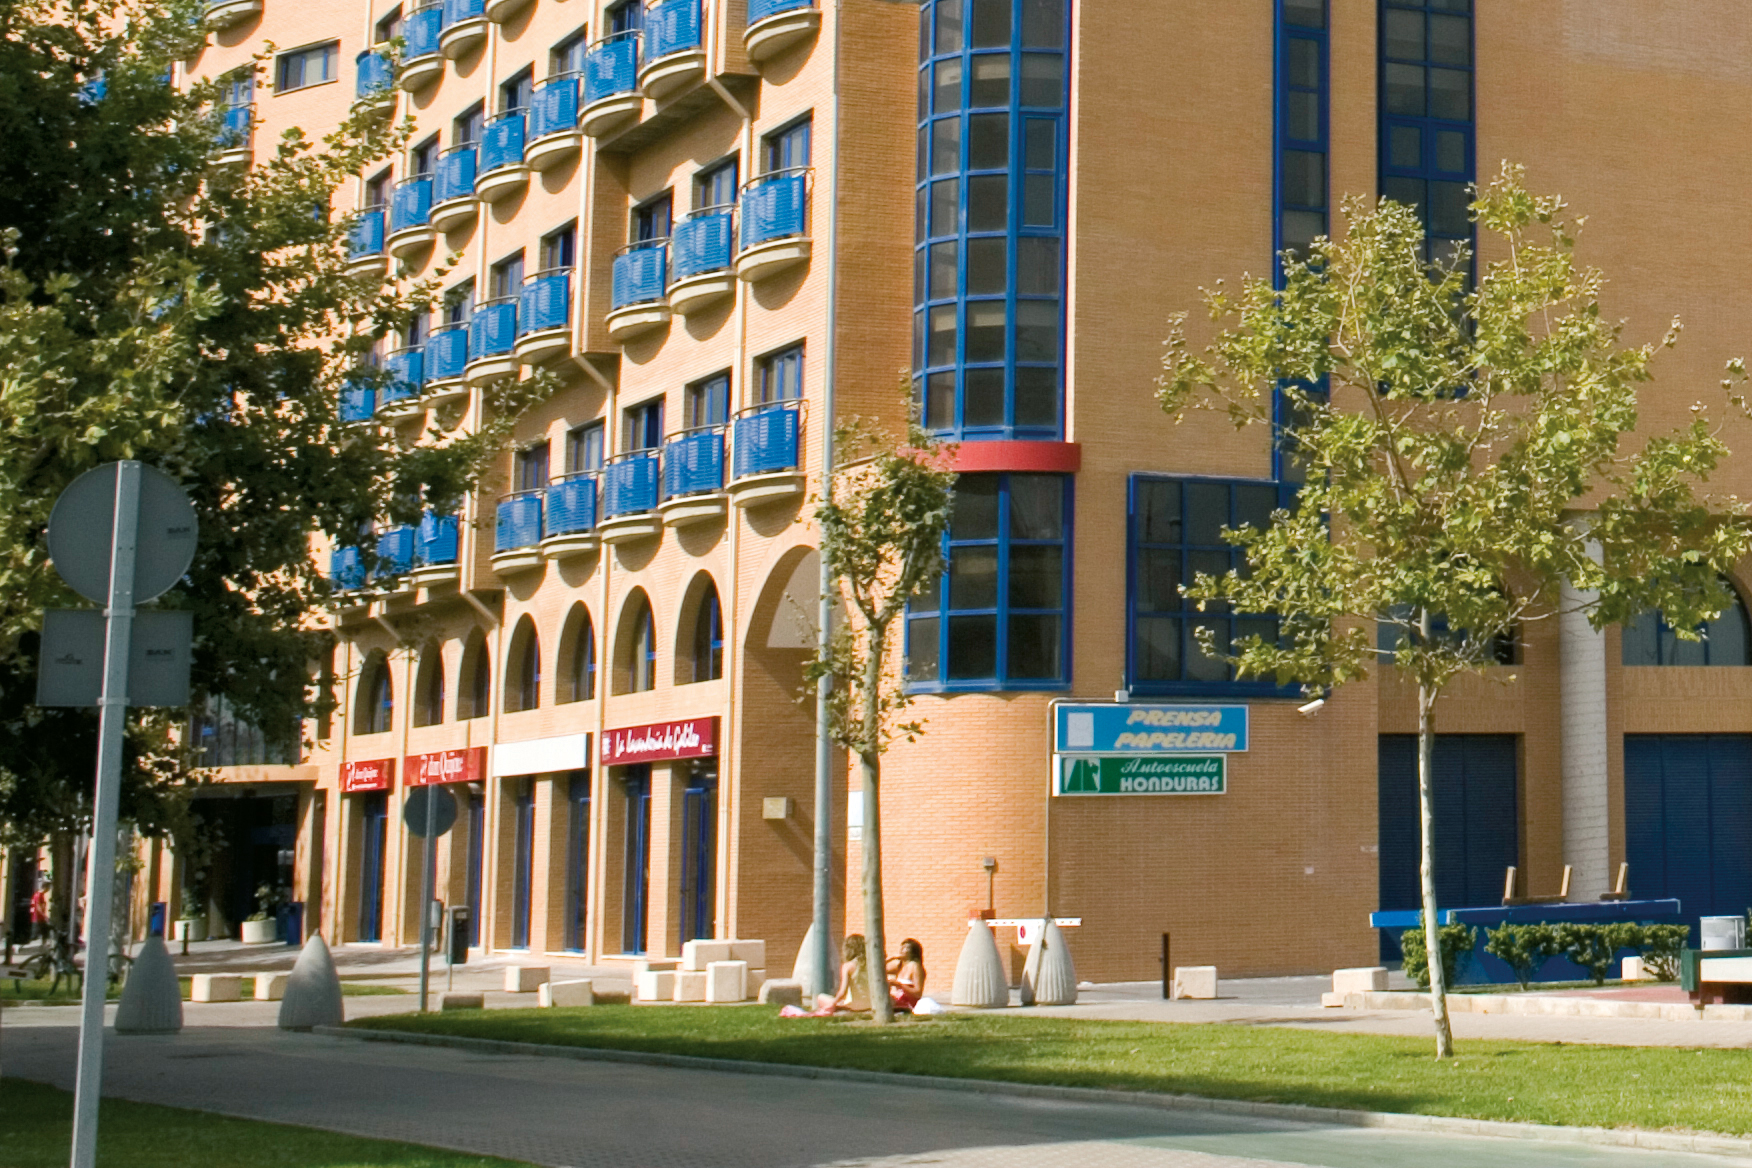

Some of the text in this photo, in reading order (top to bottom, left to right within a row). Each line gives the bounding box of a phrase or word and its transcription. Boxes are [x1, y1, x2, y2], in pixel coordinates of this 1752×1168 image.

[1126, 709, 1222, 727] PRENSA
[1114, 732, 1237, 749] PAPELERIA
[1120, 758, 1219, 774] Autoescuela
[1120, 776, 1219, 792] HONDURAS
